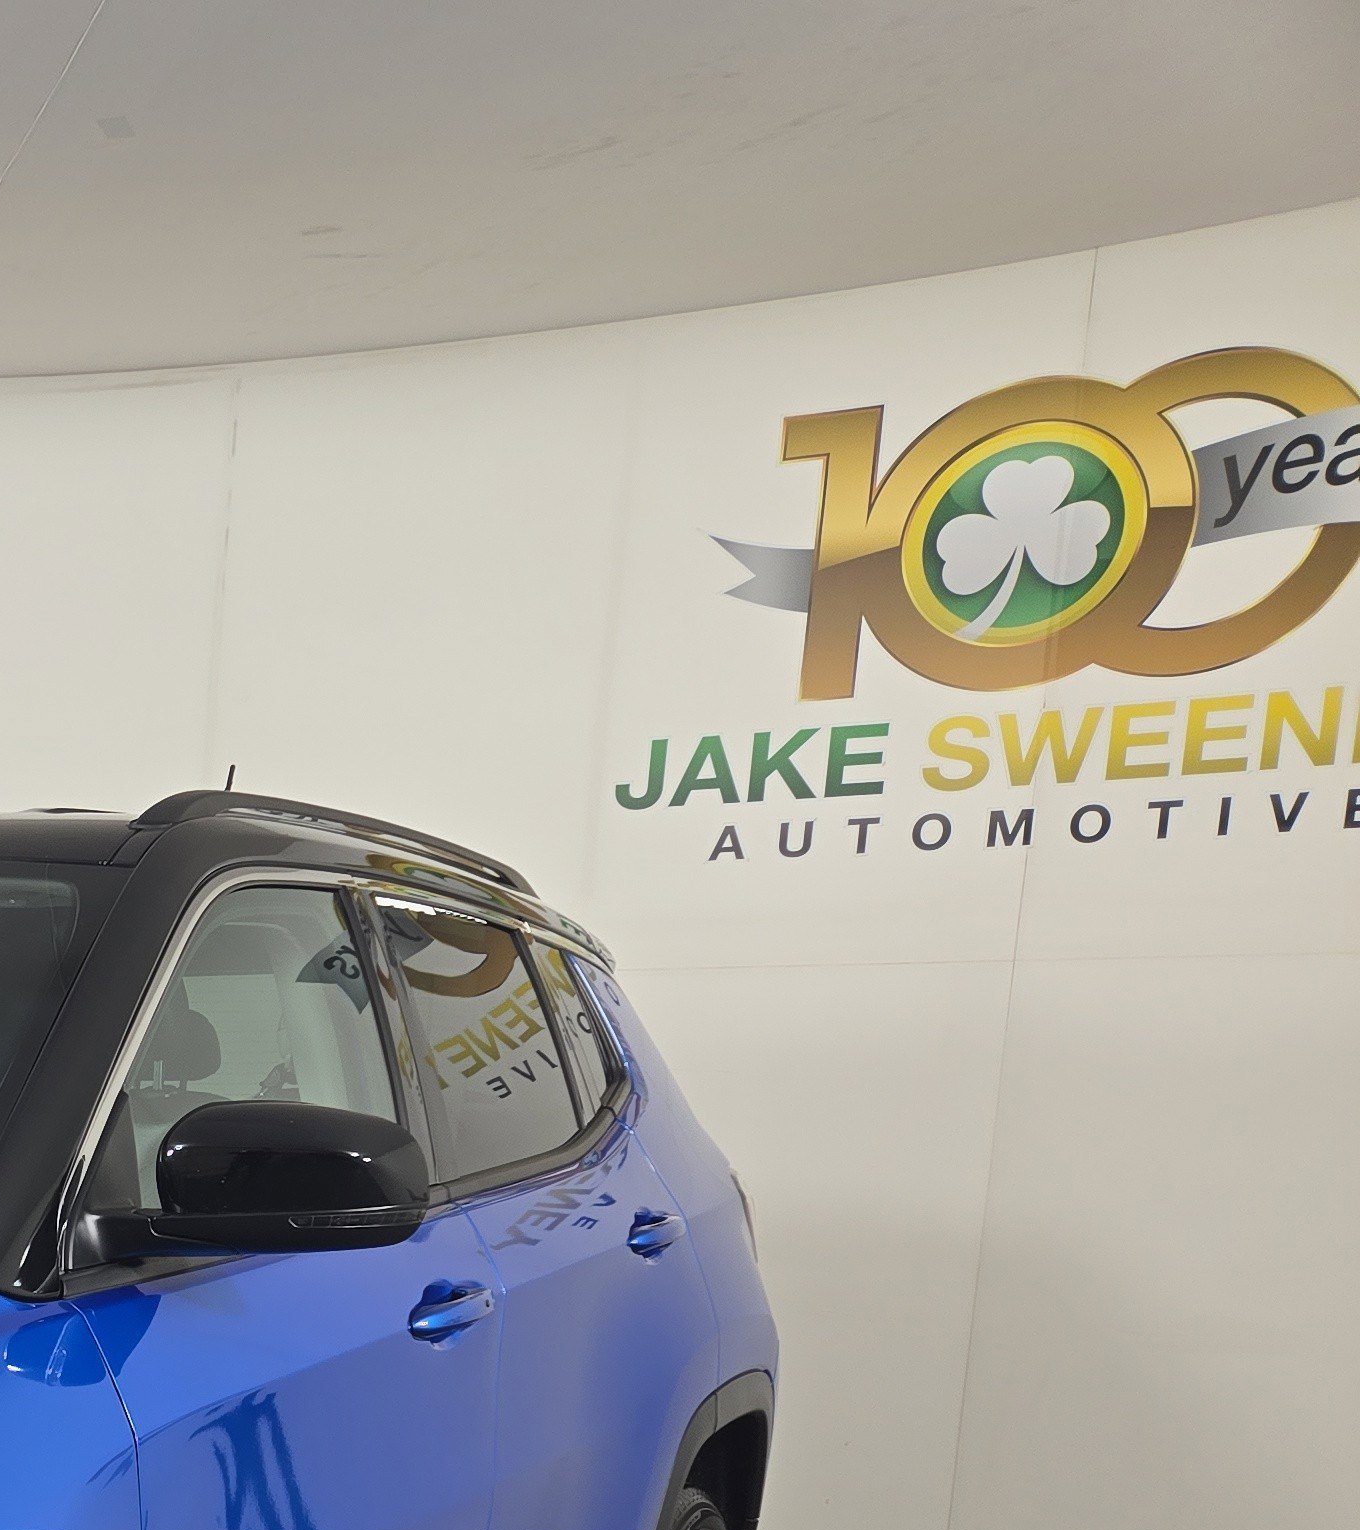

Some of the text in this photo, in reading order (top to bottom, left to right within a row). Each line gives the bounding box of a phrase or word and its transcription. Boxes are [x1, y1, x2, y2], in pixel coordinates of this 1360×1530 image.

[1214, 424, 1360, 528] yea
[615, 686, 1360, 810] JAKE SWEEN
